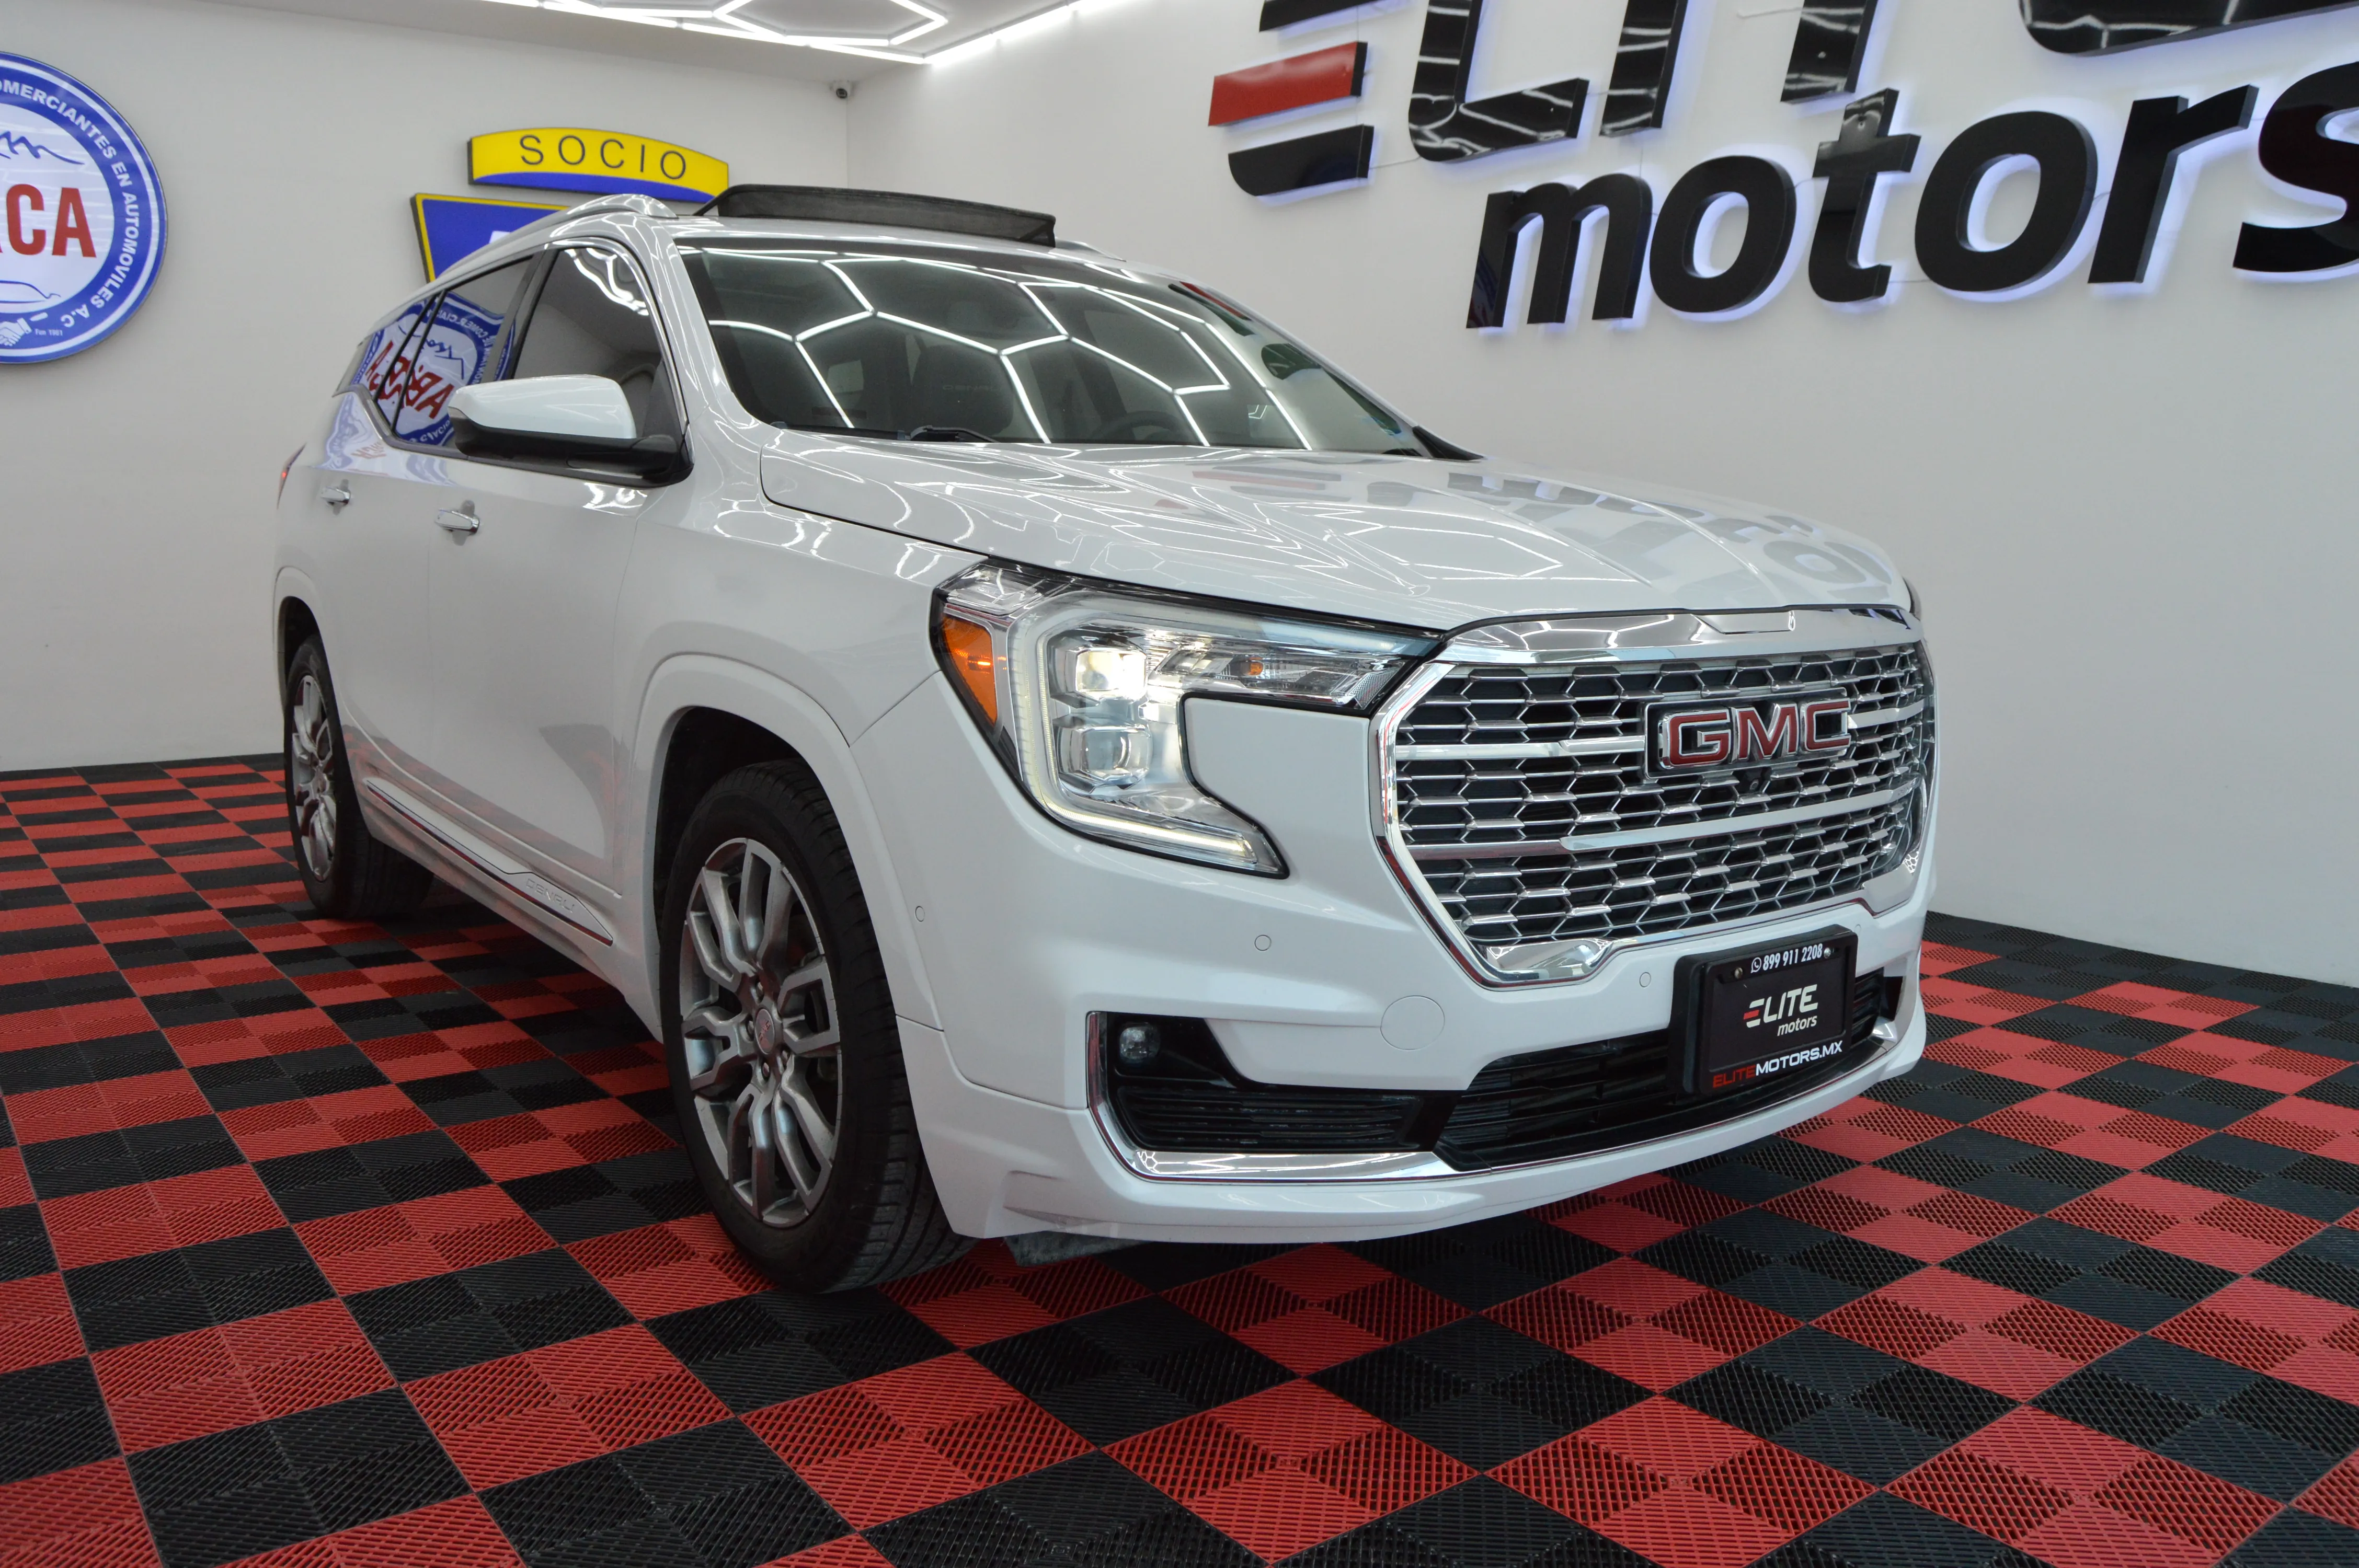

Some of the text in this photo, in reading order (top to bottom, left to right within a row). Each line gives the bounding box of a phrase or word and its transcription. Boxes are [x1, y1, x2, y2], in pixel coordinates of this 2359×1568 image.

[0, 79, 117, 158] MERCIANTES
[111, 162, 132, 187] EN
[520, 135, 686, 180] SOCIO
[1466, 61, 2359, 328] motors
[0, 183, 97, 258] CA
[90, 192, 140, 308] AUTOMOVILES
[1661, 698, 1851, 769] GMC
[526, 878, 575, 913] DENALI
[1763, 943, 1823, 971] 899 911 2208
[1743, 984, 1818, 1028] ELITE
[1777, 1016, 1817, 1036] motors
[1713, 1040, 1842, 1088] ELITEMOTORS.MX
